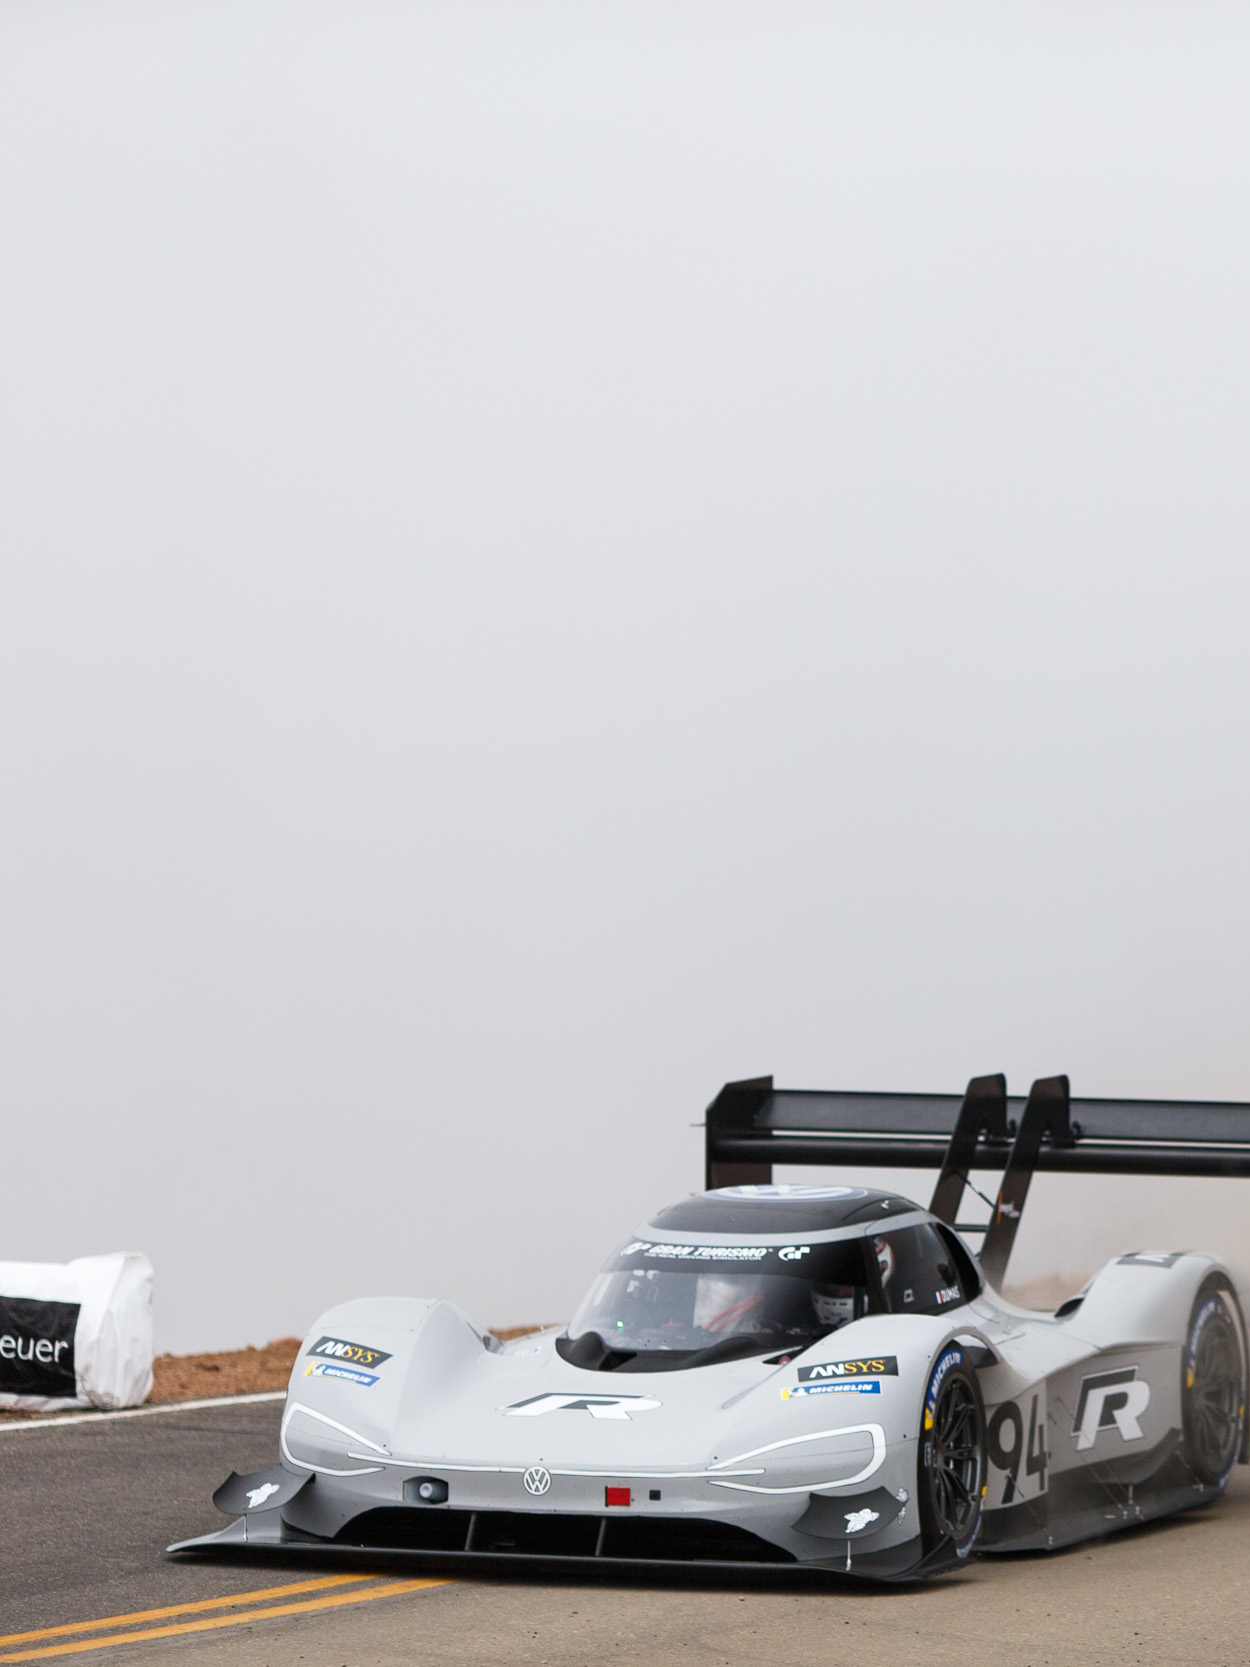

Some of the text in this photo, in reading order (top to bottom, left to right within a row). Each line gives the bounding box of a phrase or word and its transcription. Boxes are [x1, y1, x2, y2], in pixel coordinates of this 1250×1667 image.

[648, 1244, 695, 1256] GRAN
[692, 1247, 768, 1257] TURISMO
[940, 1286, 960, 1303] DUMAS
[316, 1340, 381, 1364] ANSYS
[324, 1368, 373, 1384] MICHELIN
[809, 1360, 886, 1379] ANSYS
[931, 1351, 961, 1399] MICHELIN
[809, 1384, 873, 1394] MICHELIN
[988, 1394, 1048, 1504] 94
